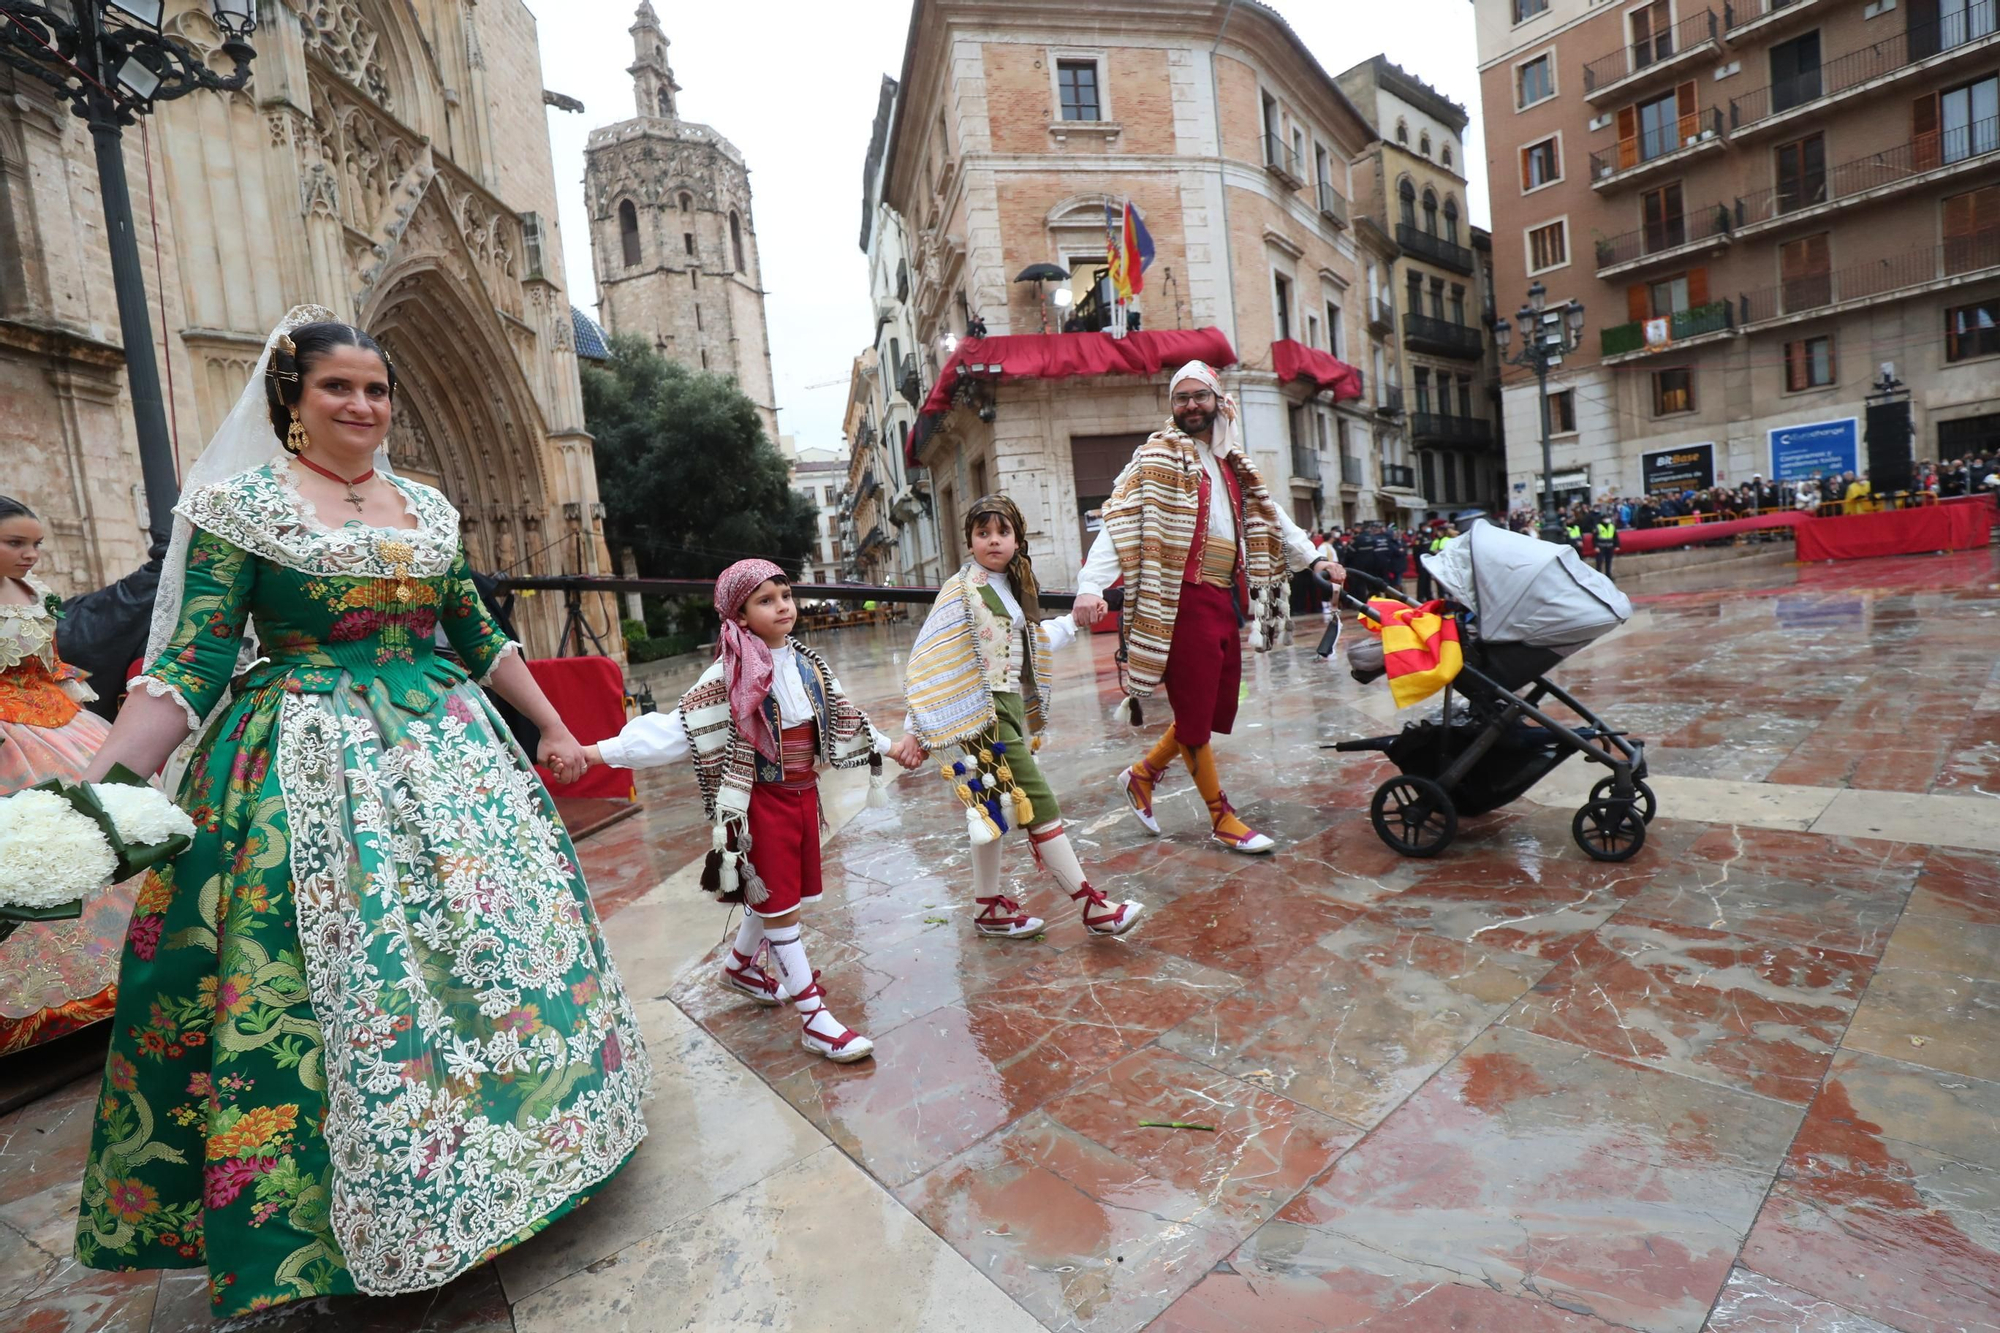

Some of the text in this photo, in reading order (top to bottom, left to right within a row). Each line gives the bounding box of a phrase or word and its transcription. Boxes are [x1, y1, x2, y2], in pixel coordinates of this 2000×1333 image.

[1656, 453, 1700, 467] BitBase
[1780, 452, 1825, 463] Compramos
[1780, 456, 1842, 469] vendemos todas
[1552, 480, 1584, 491] ATEDRAL
